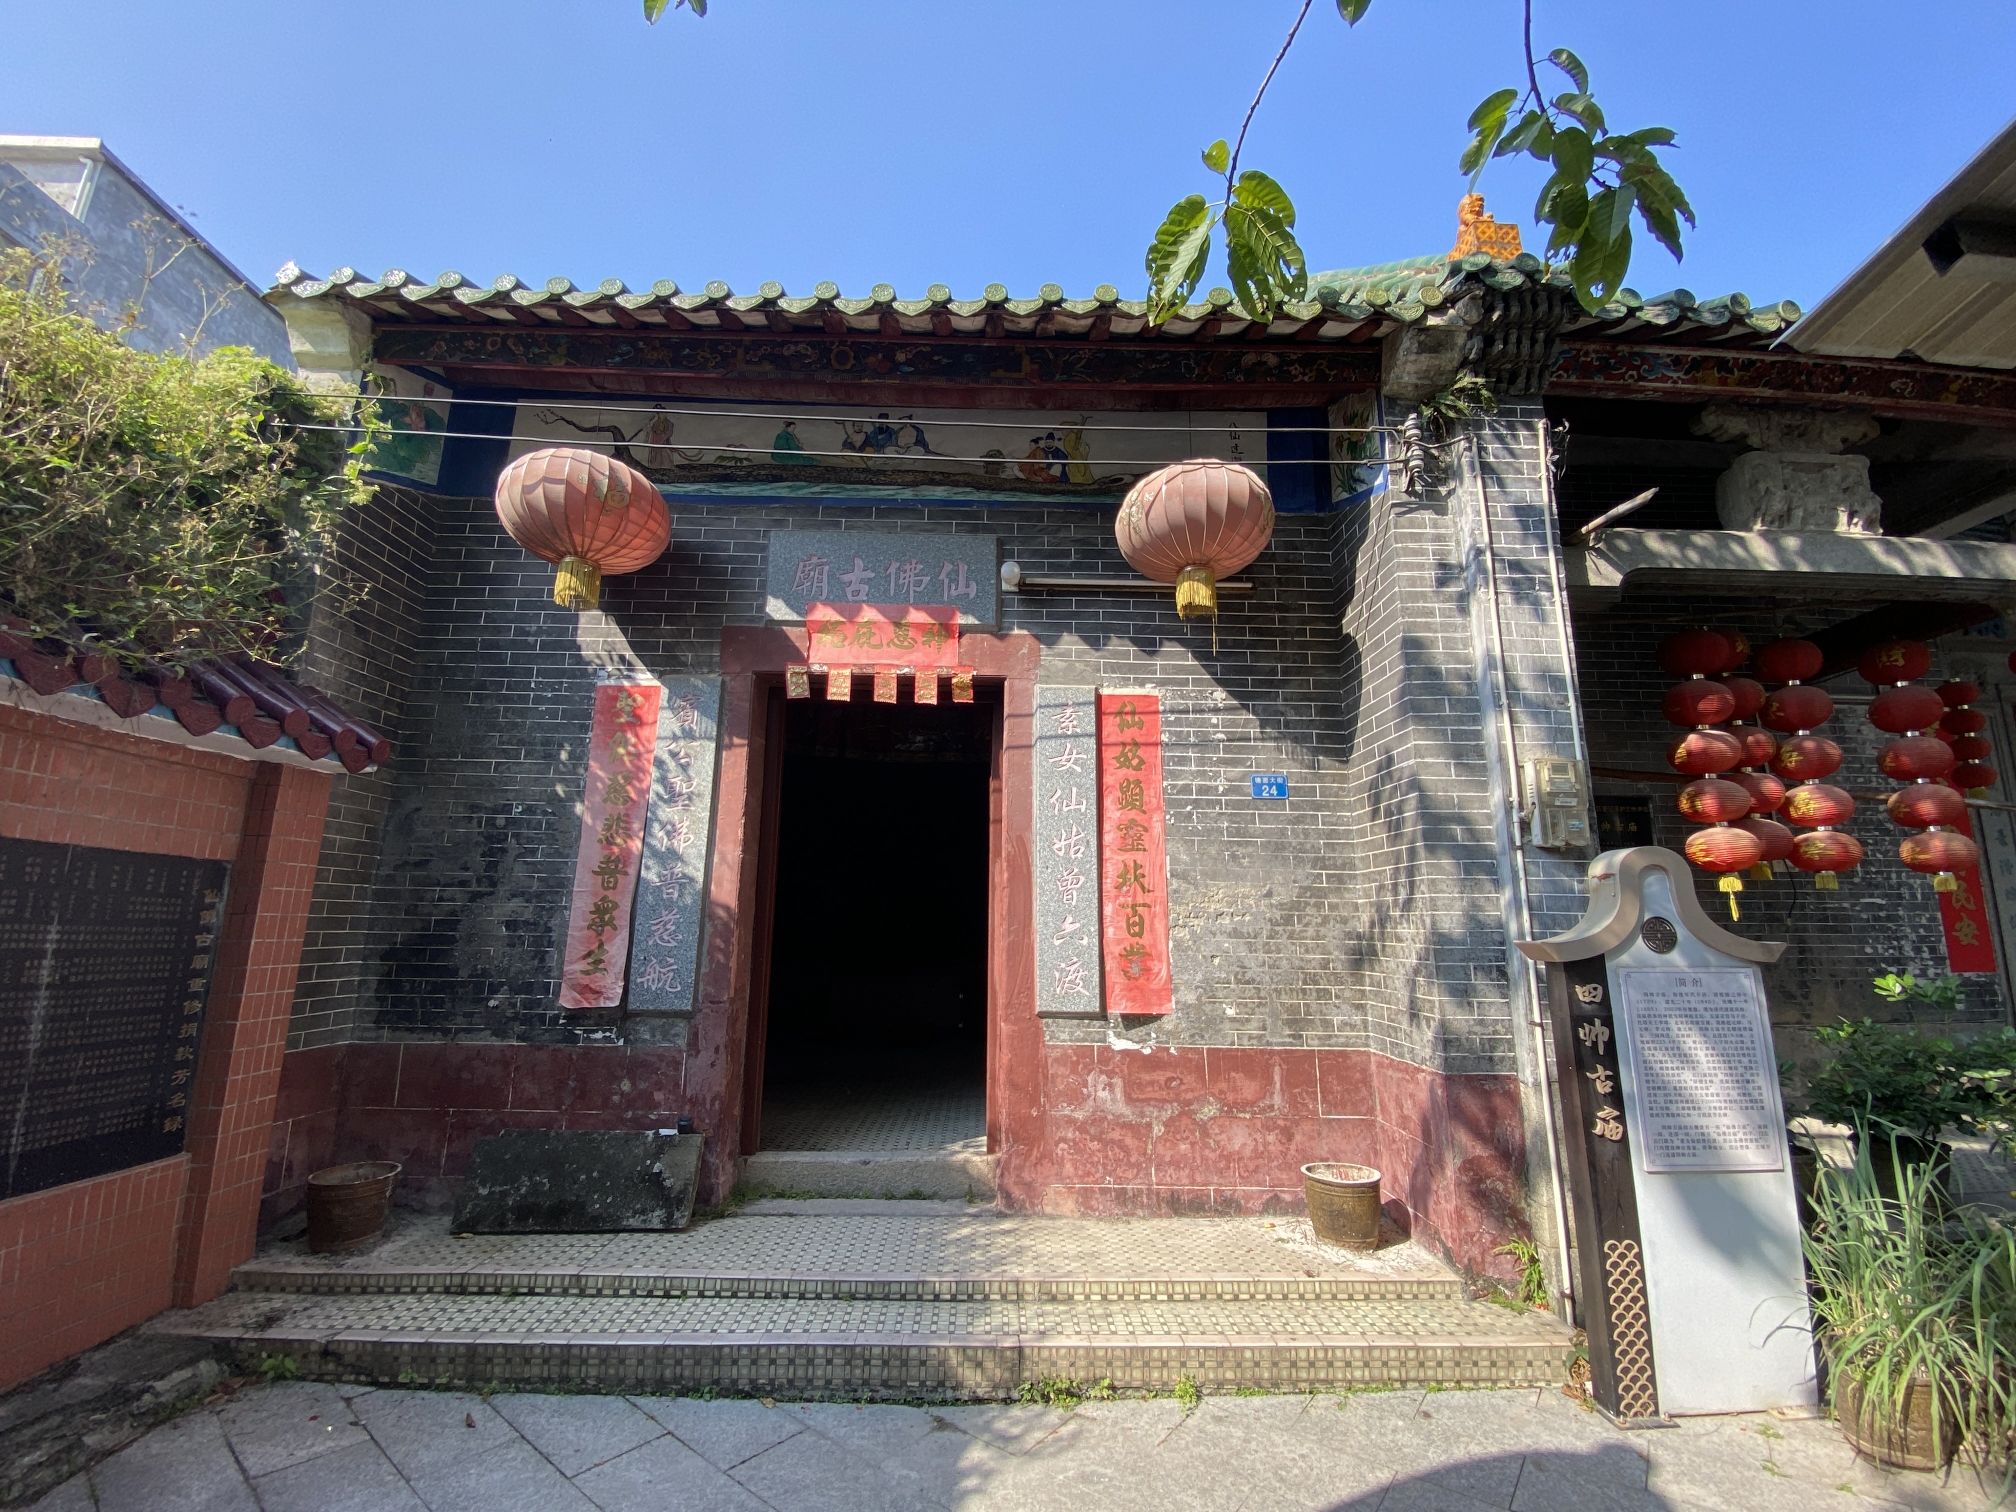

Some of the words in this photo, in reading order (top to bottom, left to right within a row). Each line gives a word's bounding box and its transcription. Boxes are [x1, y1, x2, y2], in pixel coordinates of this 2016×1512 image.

[790, 553, 978, 605] 仙佛古廟
[1261, 785, 1278, 797] 24
[1574, 982, 1625, 1142] 田帅古庙
